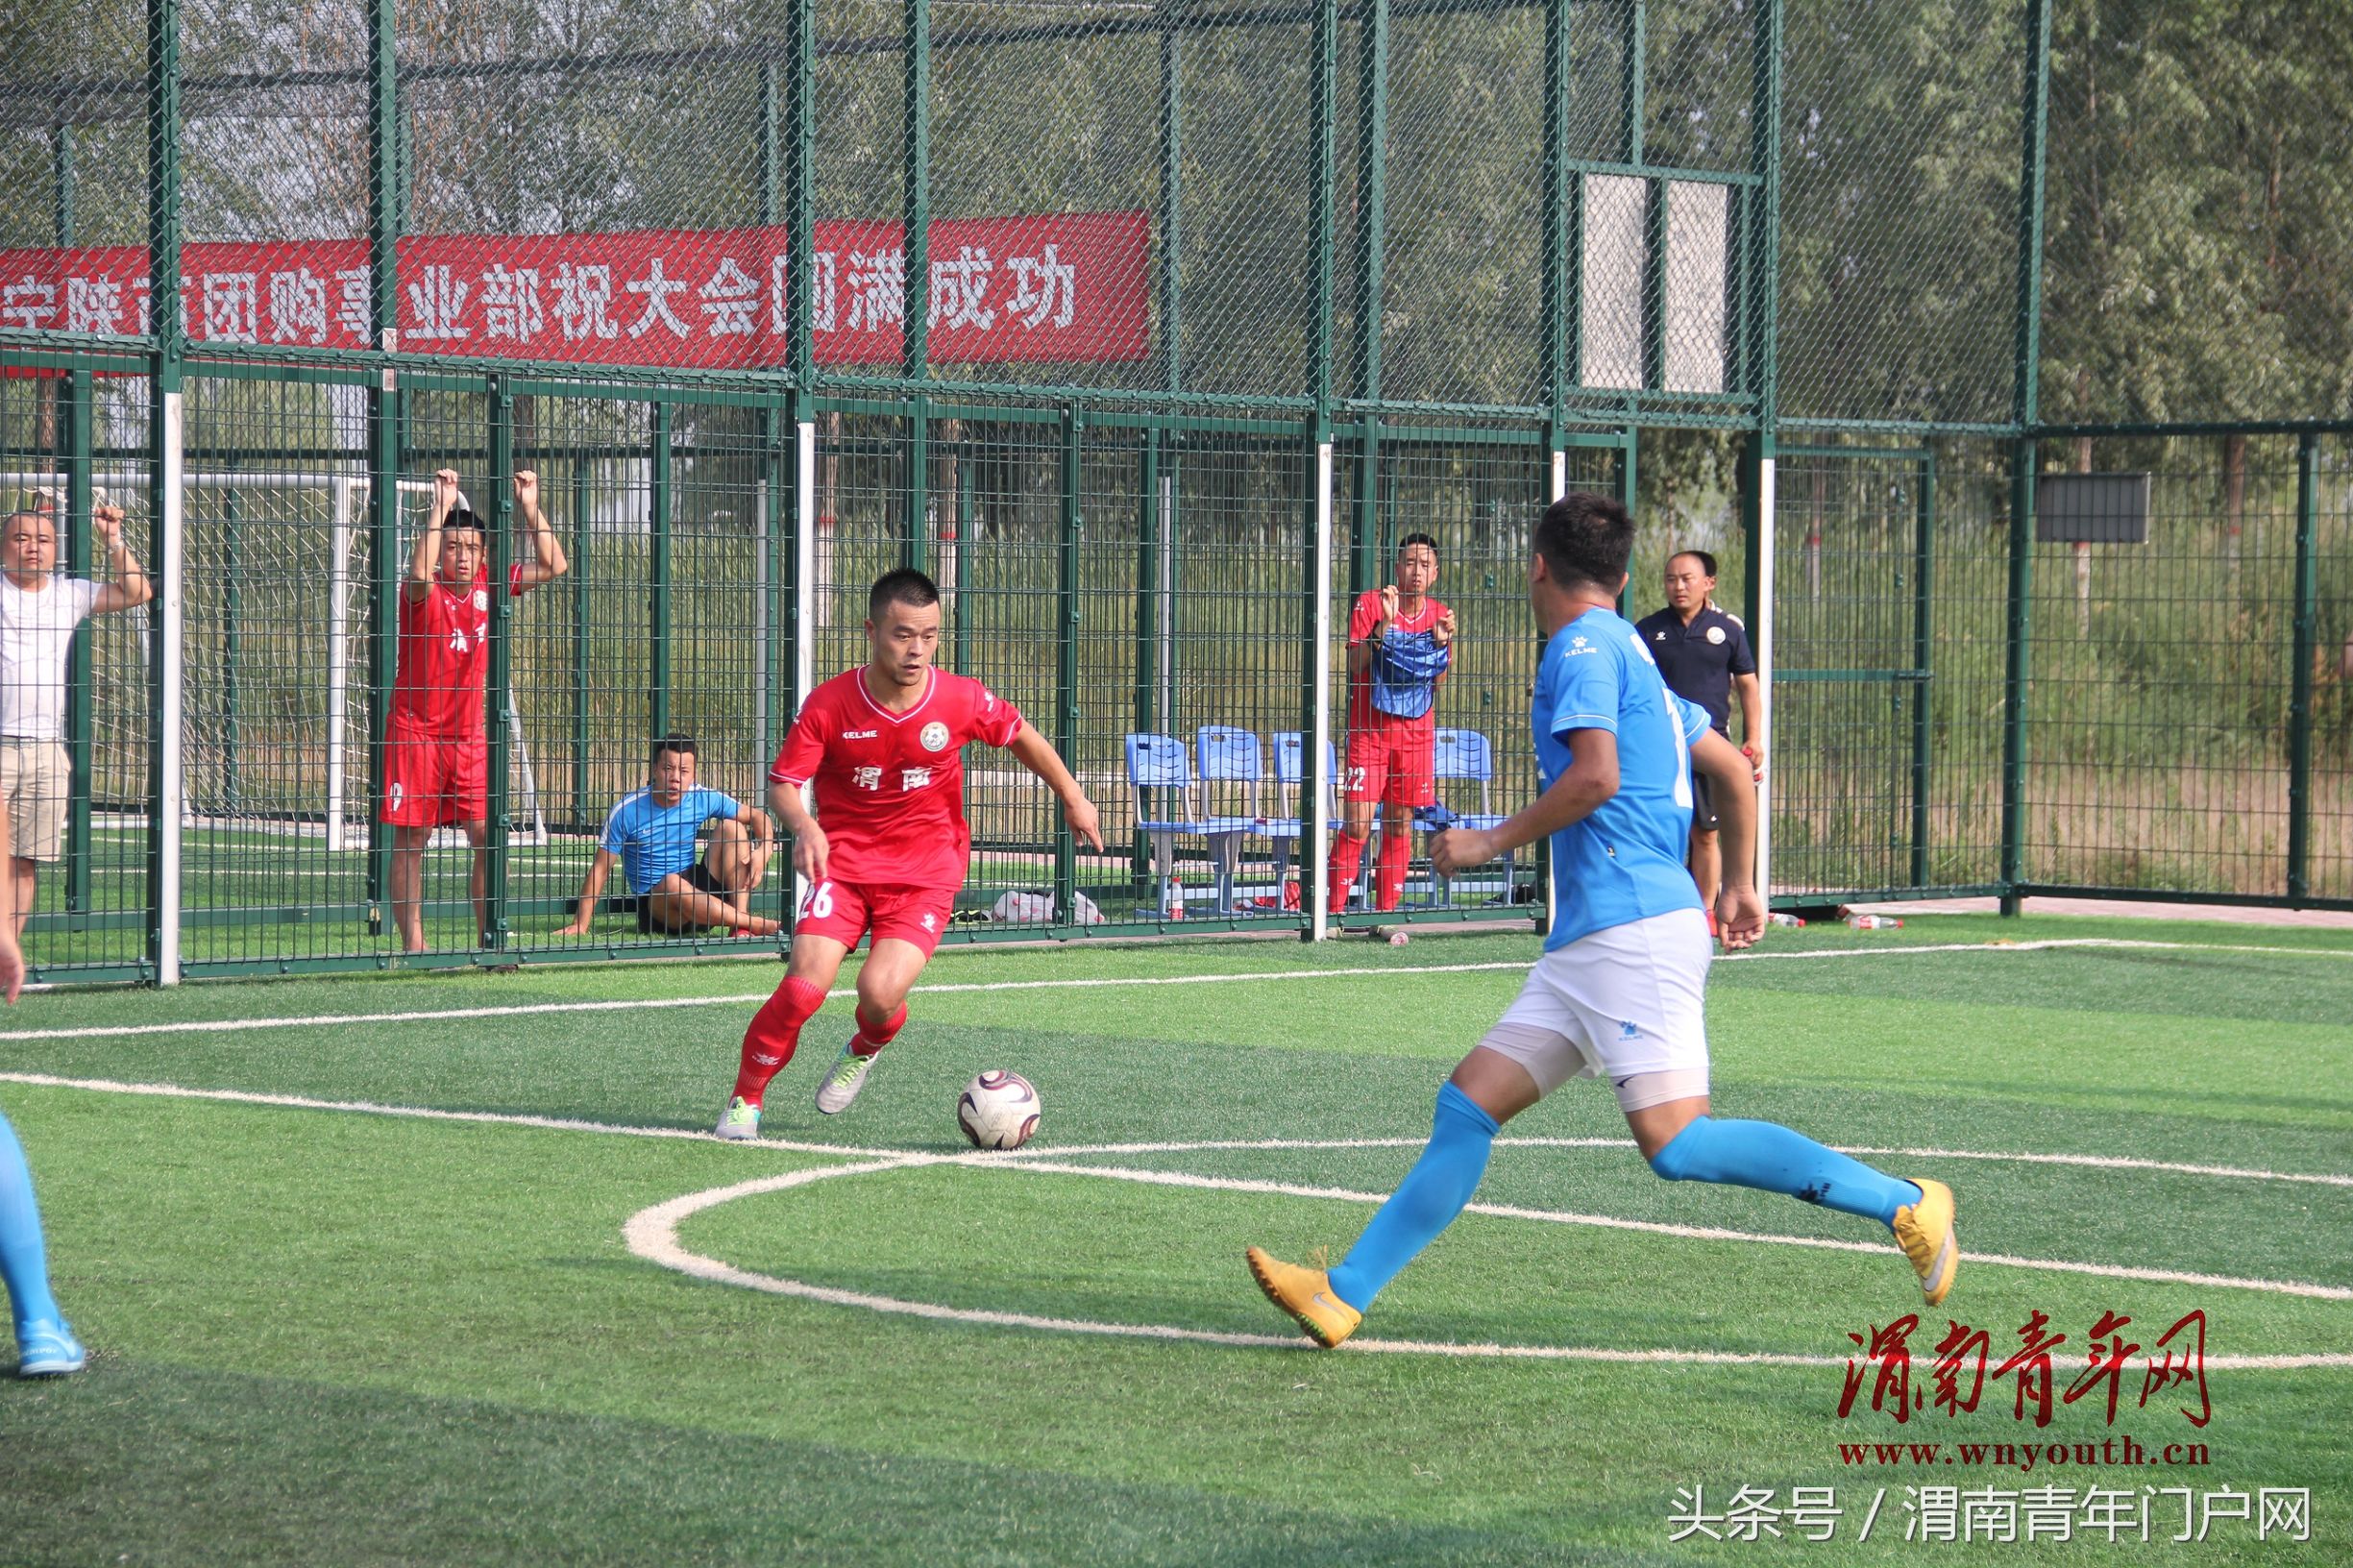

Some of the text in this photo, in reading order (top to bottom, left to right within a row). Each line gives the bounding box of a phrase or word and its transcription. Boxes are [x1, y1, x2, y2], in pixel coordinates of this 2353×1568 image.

[1564, 647, 1598, 657] KELME
[843, 730, 877, 739] KELME
[851, 766, 932, 792] 渭南
[1344, 766, 1365, 792] 22
[798, 881, 833, 919] 26
